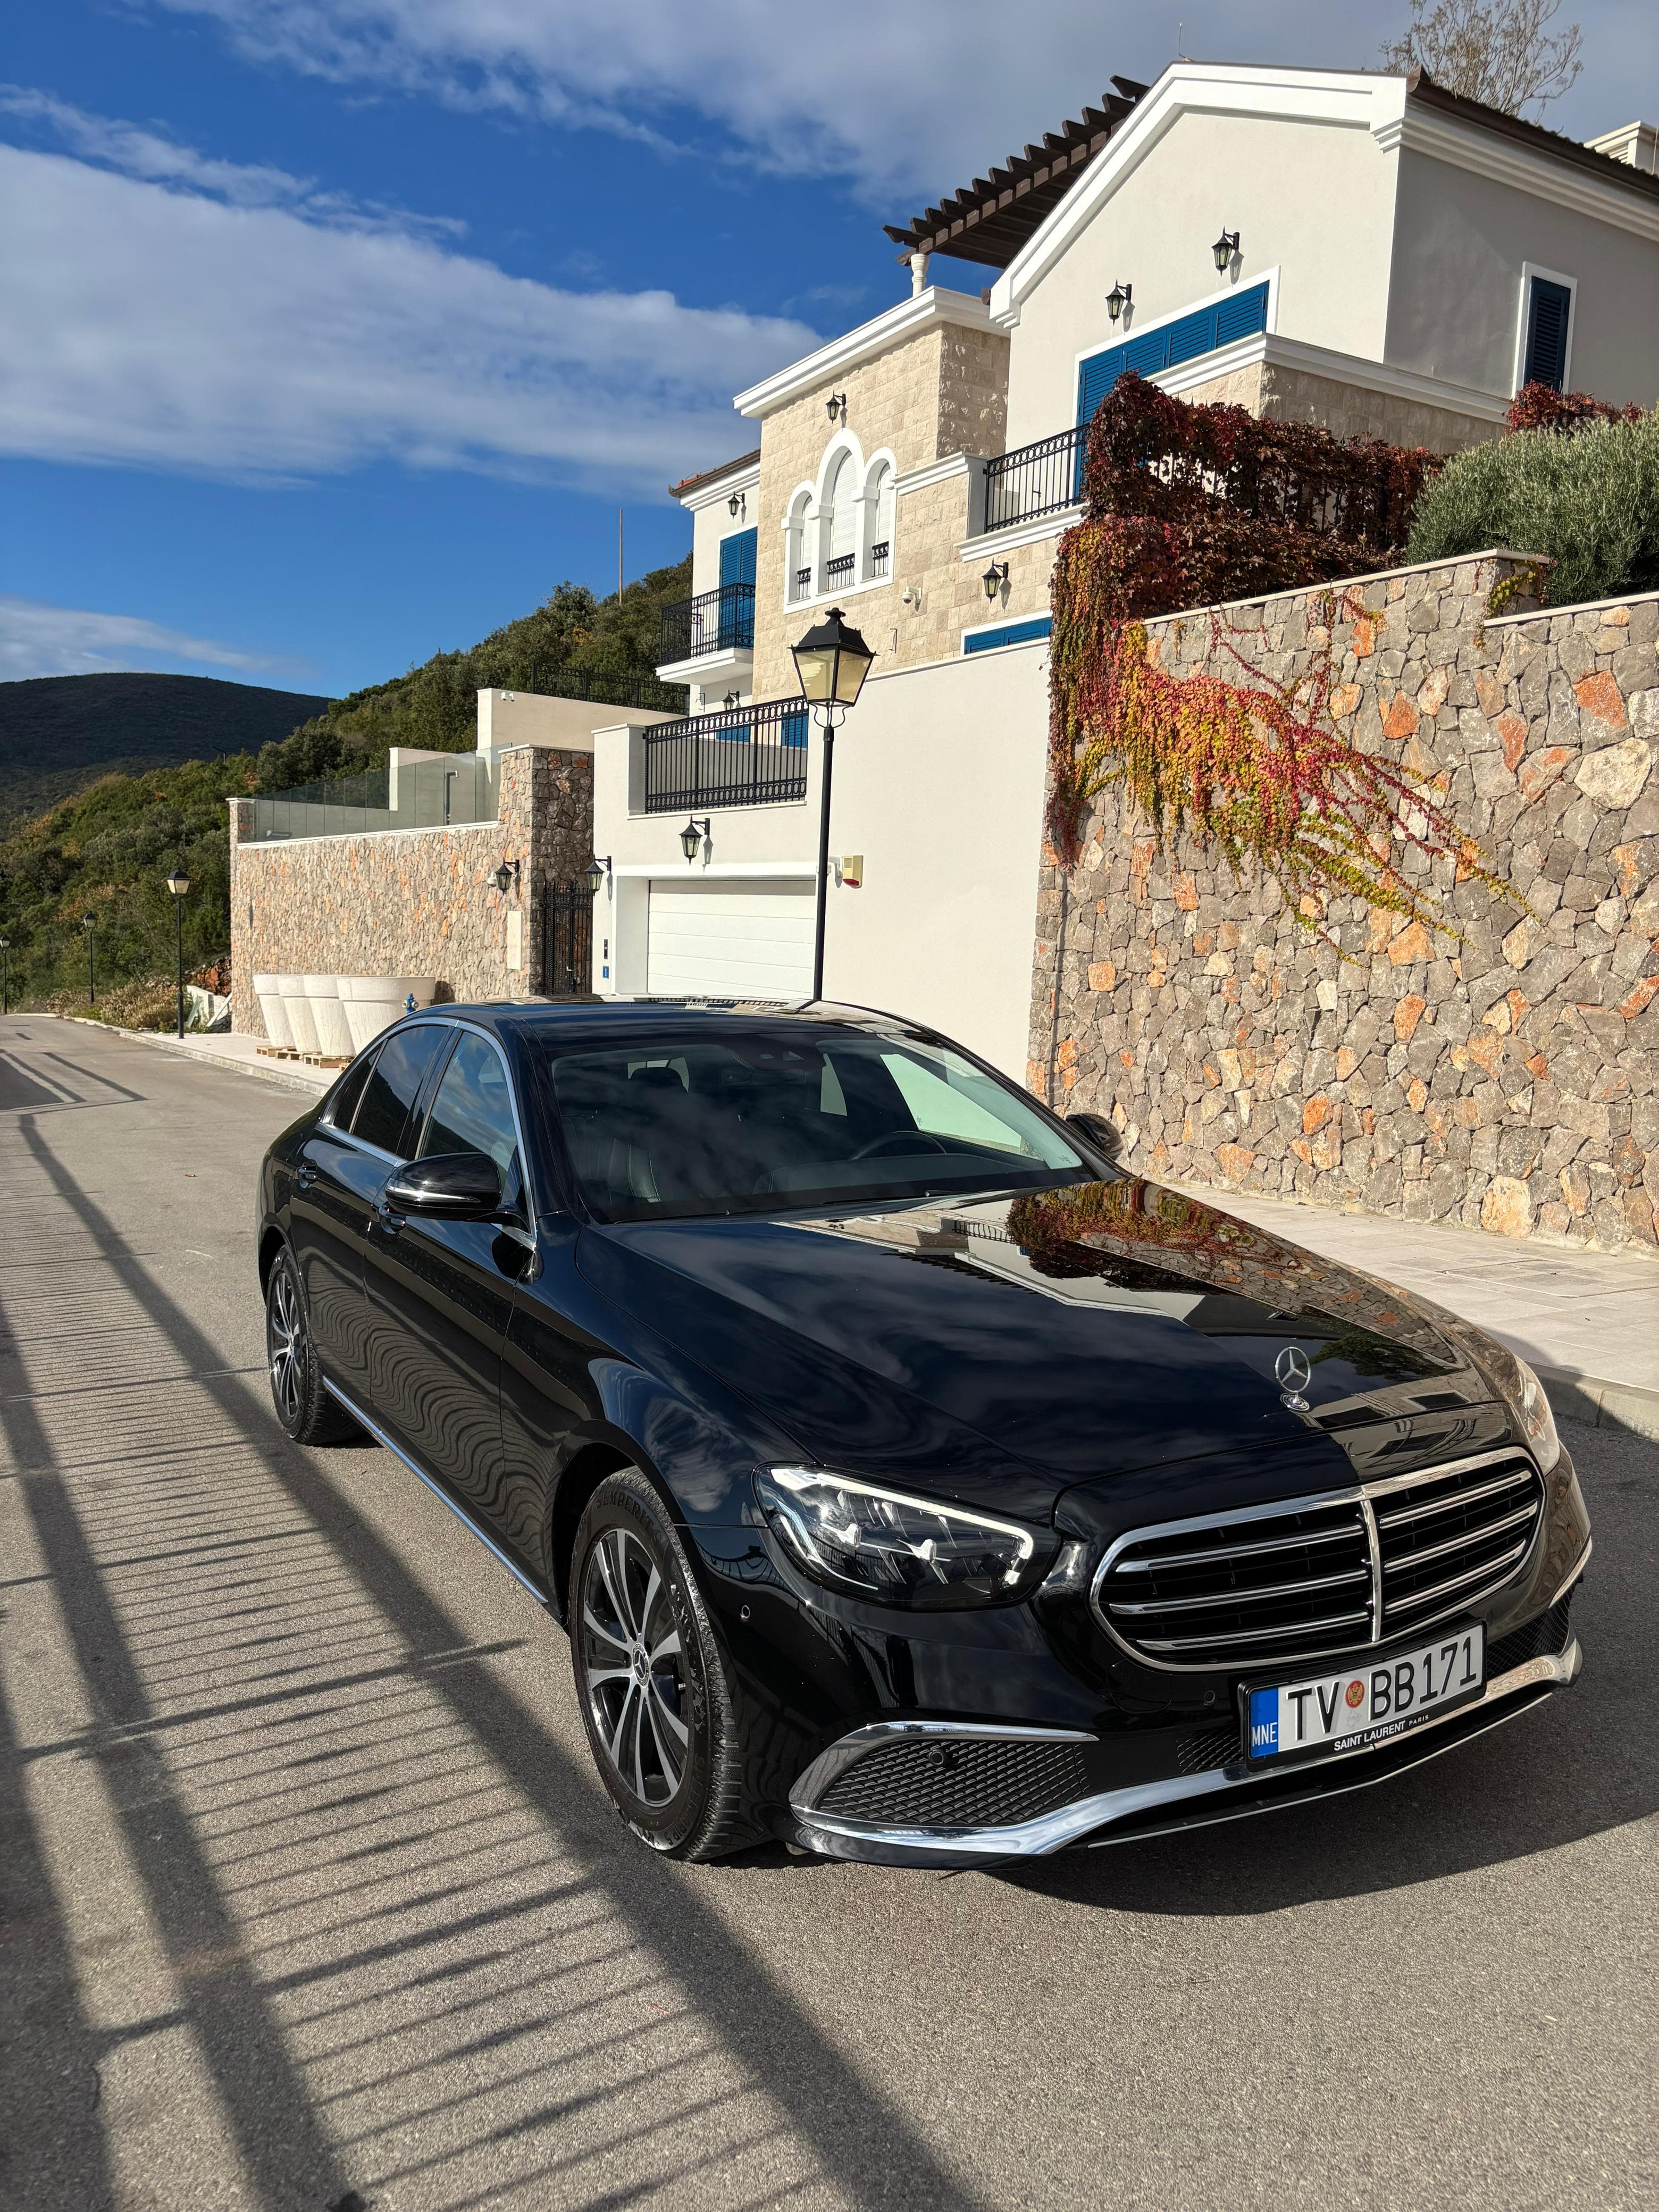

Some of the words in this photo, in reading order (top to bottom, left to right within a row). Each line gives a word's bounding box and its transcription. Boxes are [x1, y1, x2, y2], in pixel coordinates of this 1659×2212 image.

[1287, 1681, 1339, 1740] TV
[1369, 1636, 1477, 1721] BB171
[1252, 1722, 1277, 1747] MNE
[1334, 1735, 1362, 1751] SAINT
[1364, 1720, 1406, 1742] LAURENT
[1409, 1714, 1429, 1726] PARIS
